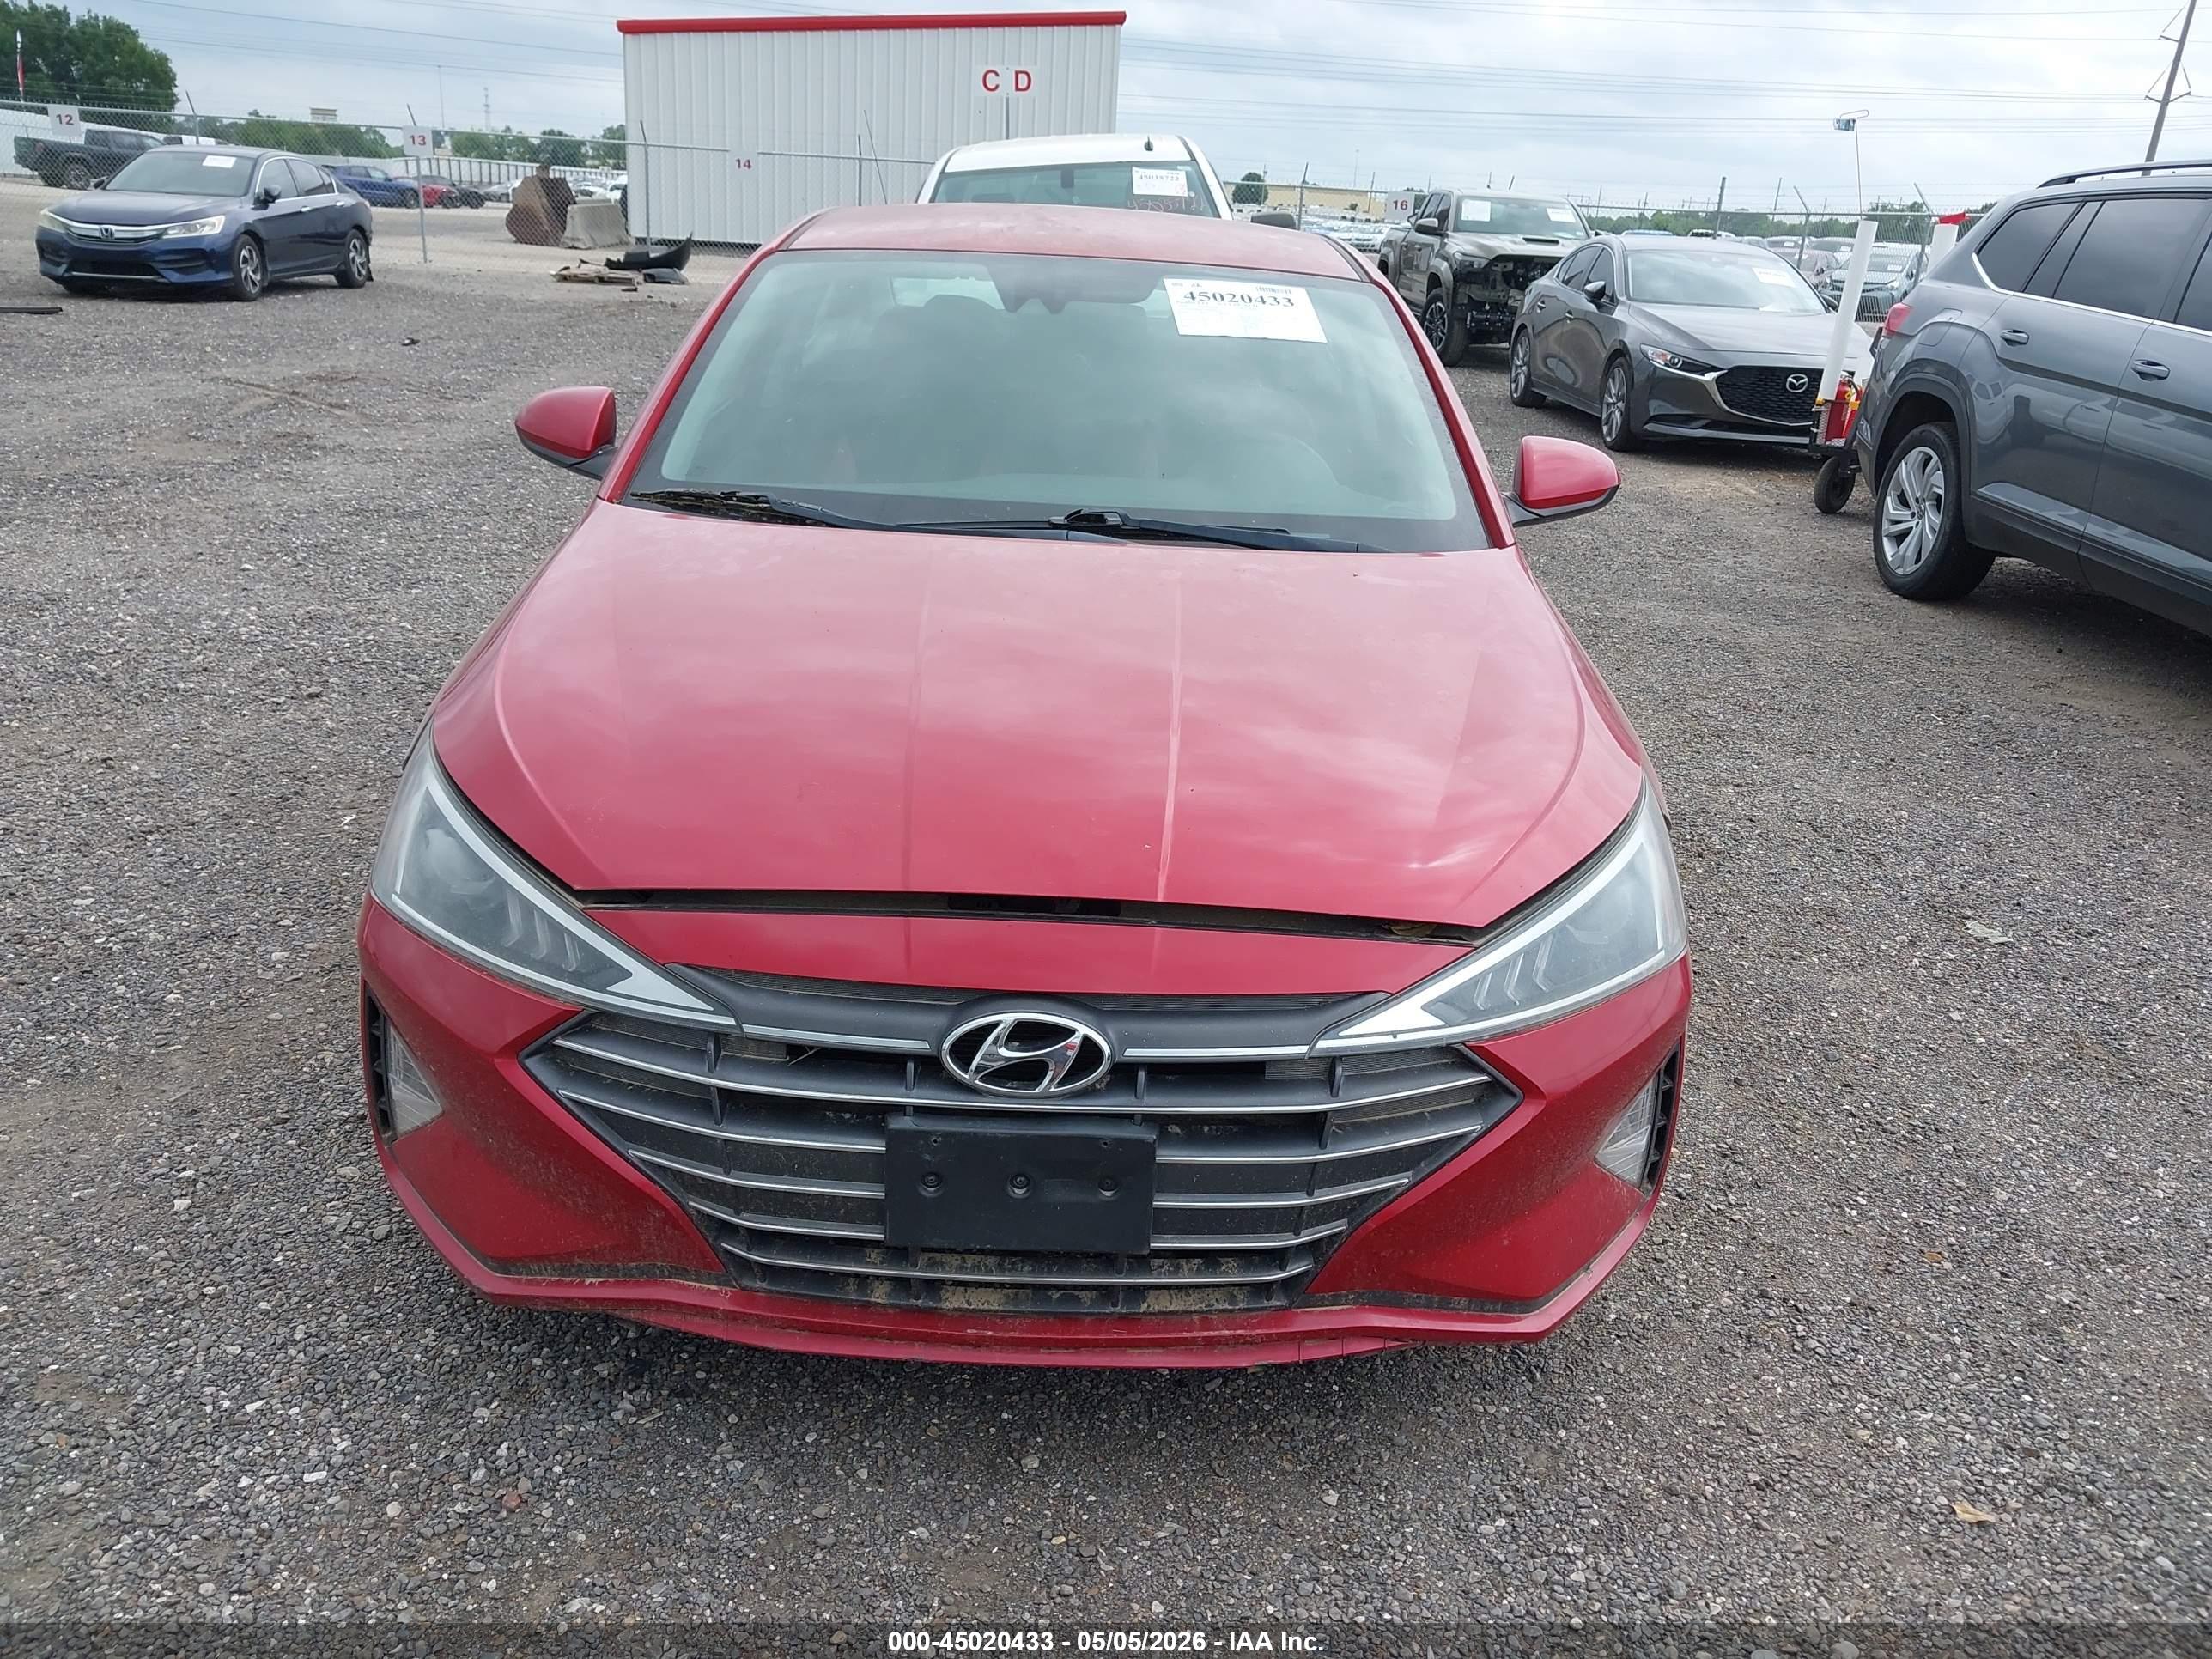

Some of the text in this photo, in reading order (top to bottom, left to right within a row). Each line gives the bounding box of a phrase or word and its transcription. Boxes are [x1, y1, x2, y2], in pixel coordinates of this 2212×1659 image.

[981, 70, 1032, 92] C D
[55, 113, 75, 125] 12
[410, 134, 427, 146] 13
[735, 158, 752, 169] 14
[1392, 199, 1408, 211] 16
[1182, 290, 1295, 308] 45020433
